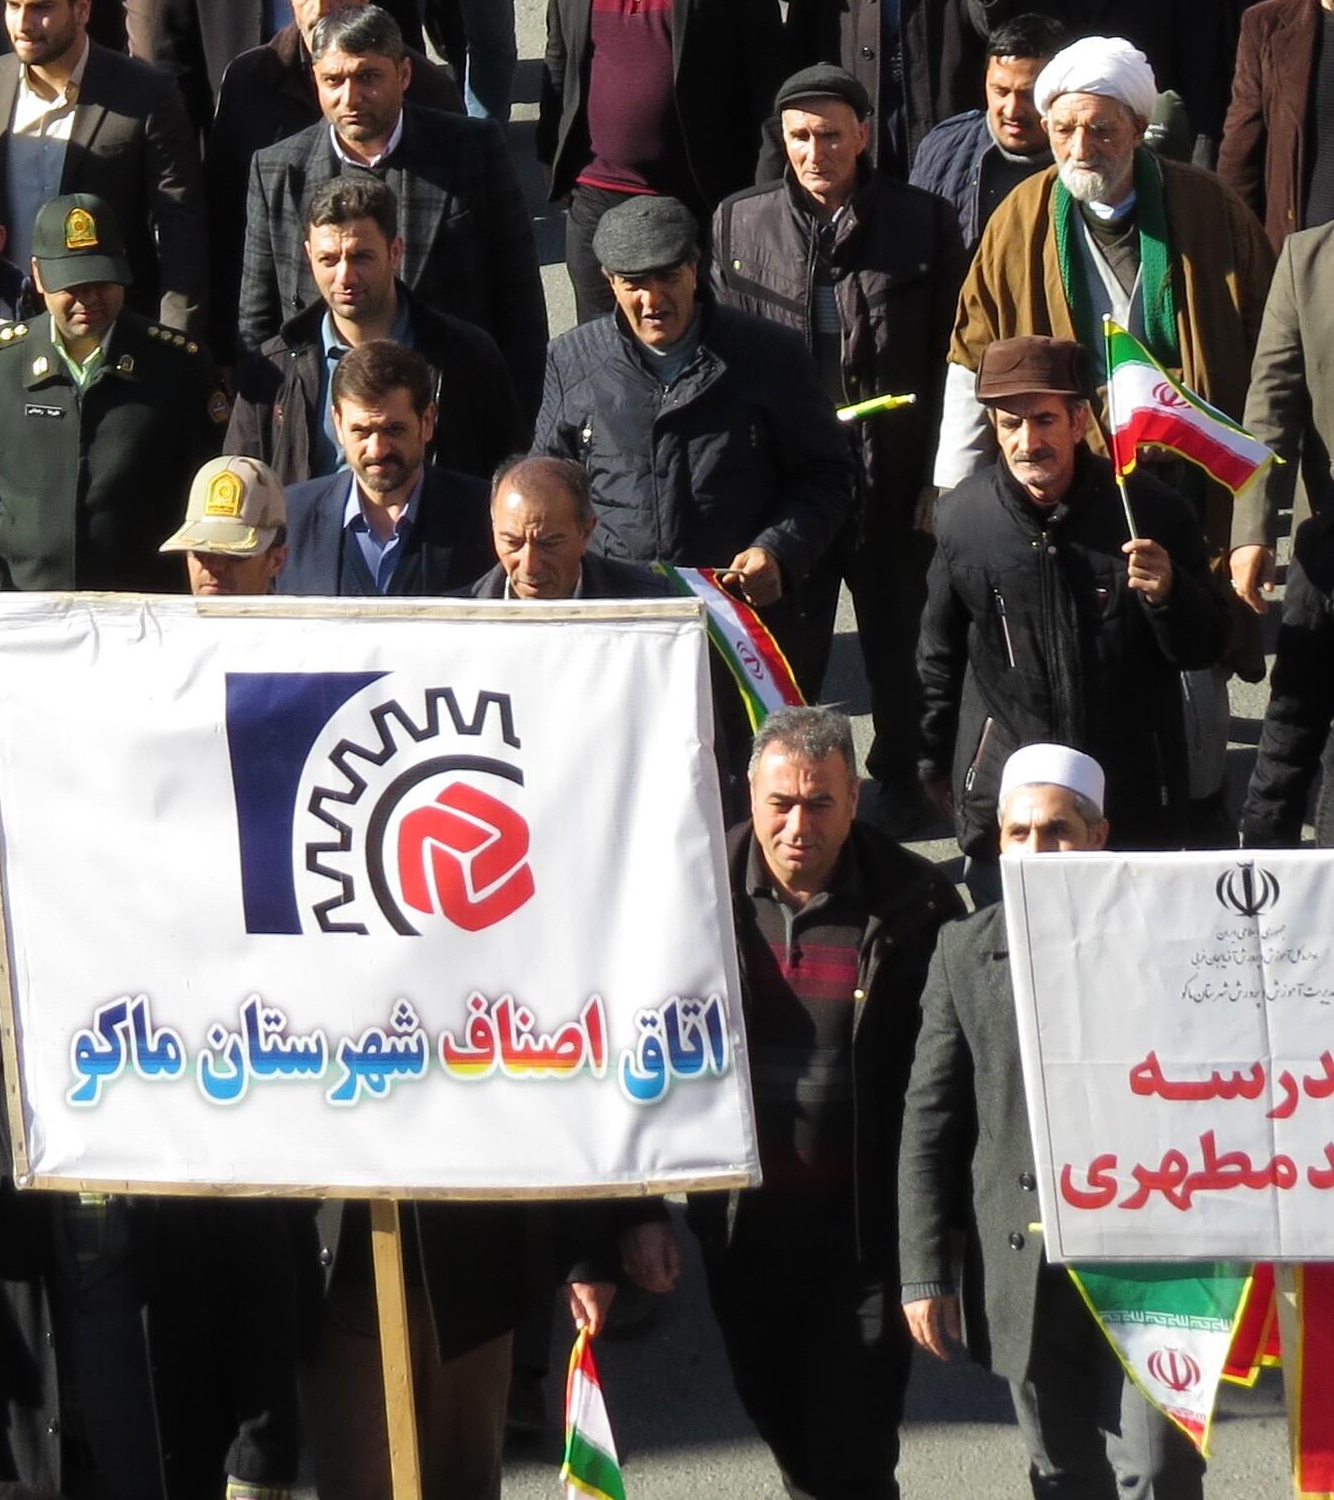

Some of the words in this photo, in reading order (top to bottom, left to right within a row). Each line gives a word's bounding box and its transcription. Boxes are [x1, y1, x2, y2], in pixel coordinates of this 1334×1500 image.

[1180, 972, 1199, 1001] ماکو
[1193, 981, 1229, 1004] شهرستان
[1228, 979, 1261, 1009] پرورش
[1267, 979, 1303, 1001] آموزش
[68, 996, 183, 1104] ماکو
[196, 994, 427, 1104] شهرستان
[439, 994, 607, 1077] اصناف
[617, 996, 729, 1108] اتاق
[1059, 1131, 1299, 1212] مطهری
